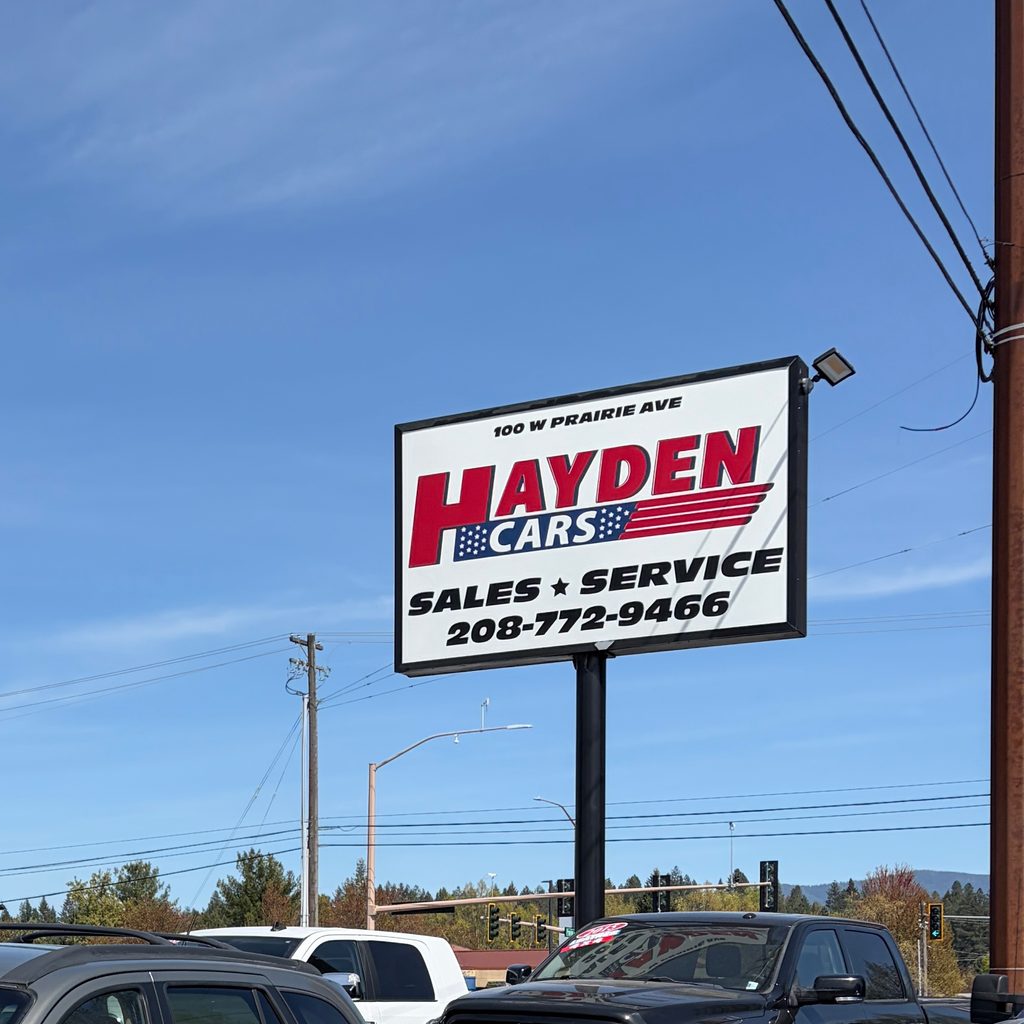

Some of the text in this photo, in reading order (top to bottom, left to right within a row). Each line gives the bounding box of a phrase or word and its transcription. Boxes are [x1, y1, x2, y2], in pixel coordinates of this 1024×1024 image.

[494, 396, 683, 437] 100 W PRAIRIE AVE
[408, 425, 762, 568] HAYDEN
[489, 510, 598, 553] CARS
[408, 547, 784, 616] SALES SERVICE
[446, 591, 731, 647] 208-772-9466
